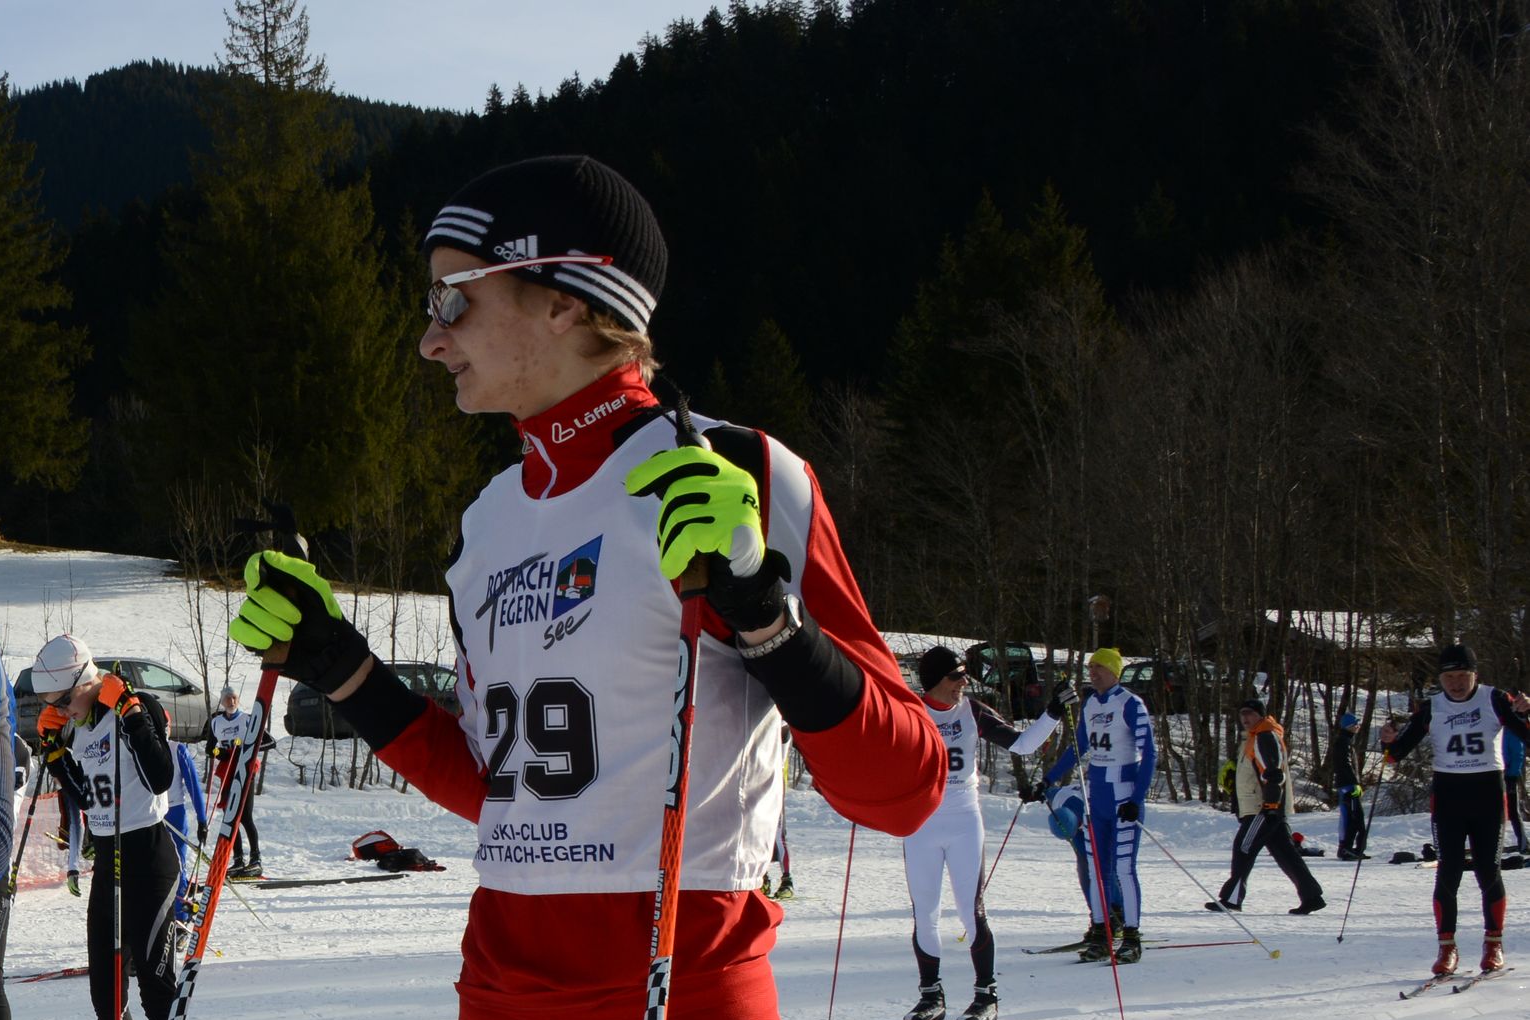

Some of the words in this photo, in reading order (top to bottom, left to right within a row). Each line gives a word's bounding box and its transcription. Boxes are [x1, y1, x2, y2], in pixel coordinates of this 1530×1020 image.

[485, 560, 555, 600] ROTTACH
[483, 676, 600, 803] 29
[1090, 731, 1113, 752] 44
[1446, 731, 1486, 757] 45
[491, 822, 569, 842] SKI-CLUB
